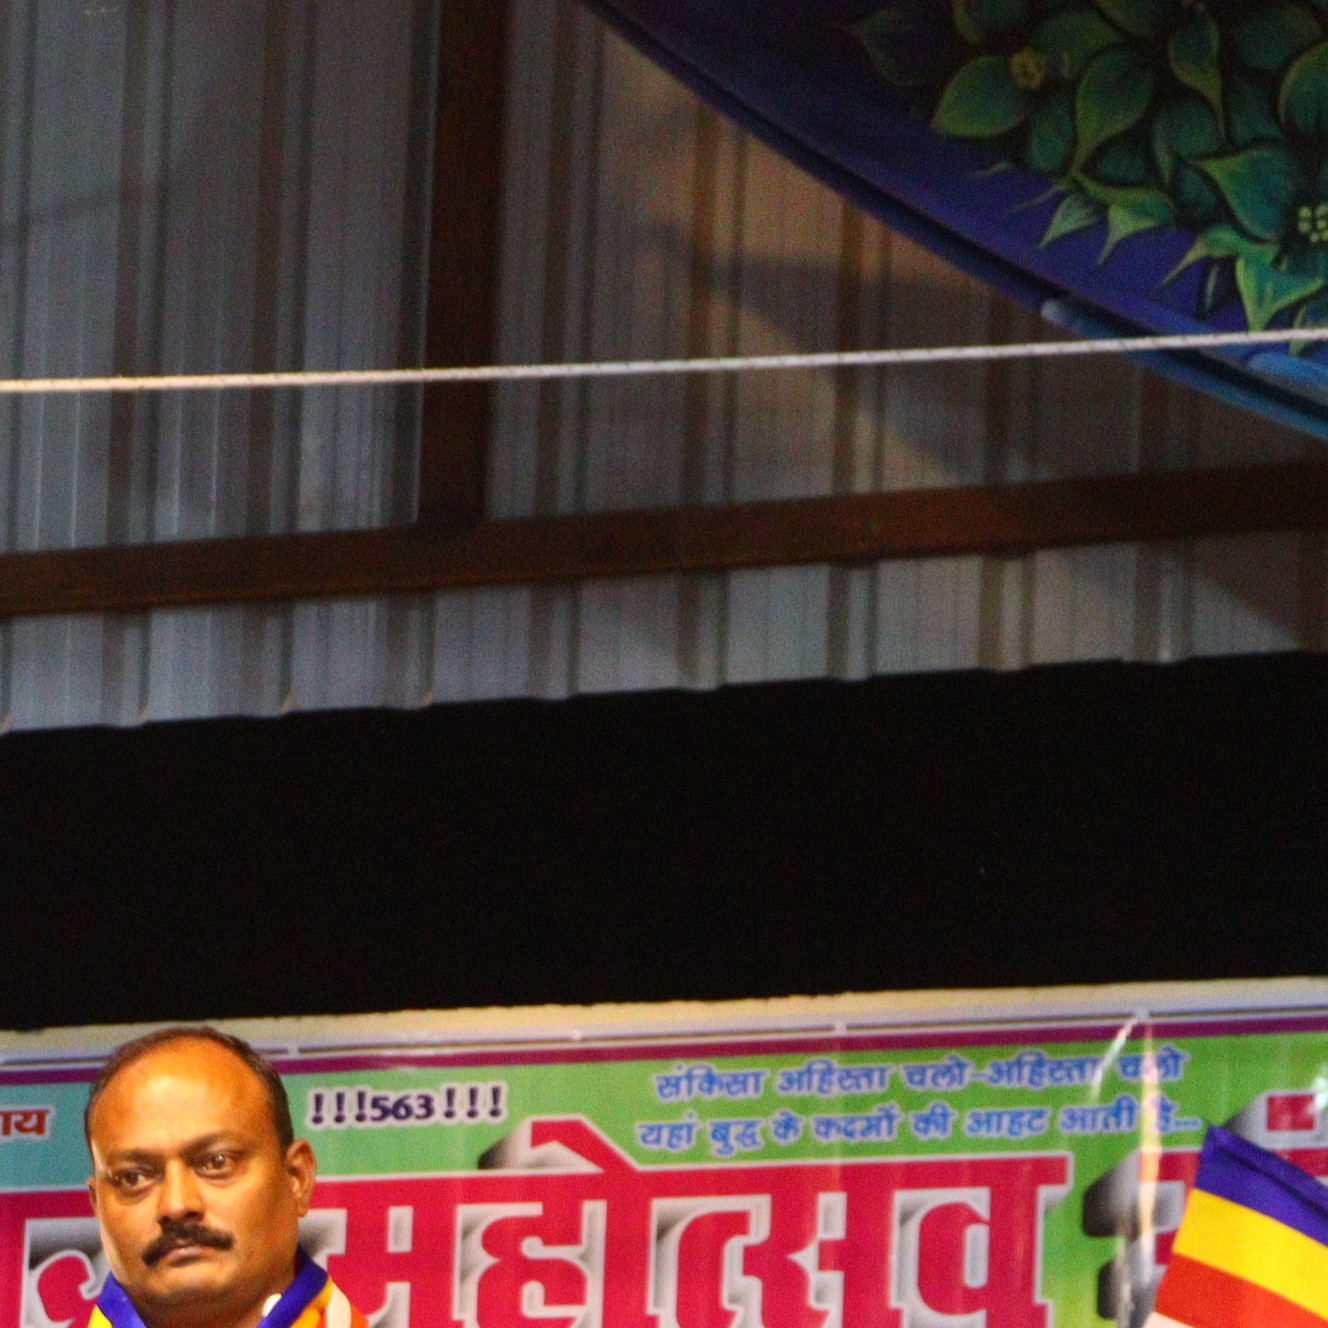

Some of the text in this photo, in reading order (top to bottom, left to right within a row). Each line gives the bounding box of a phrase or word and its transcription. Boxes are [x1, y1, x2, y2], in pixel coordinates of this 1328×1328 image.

[770, 1110, 803, 1144] के
[911, 1102, 955, 1136] की
[965, 1107, 1050, 1137] आहट
[1060, 1095, 1140, 1132] आती
